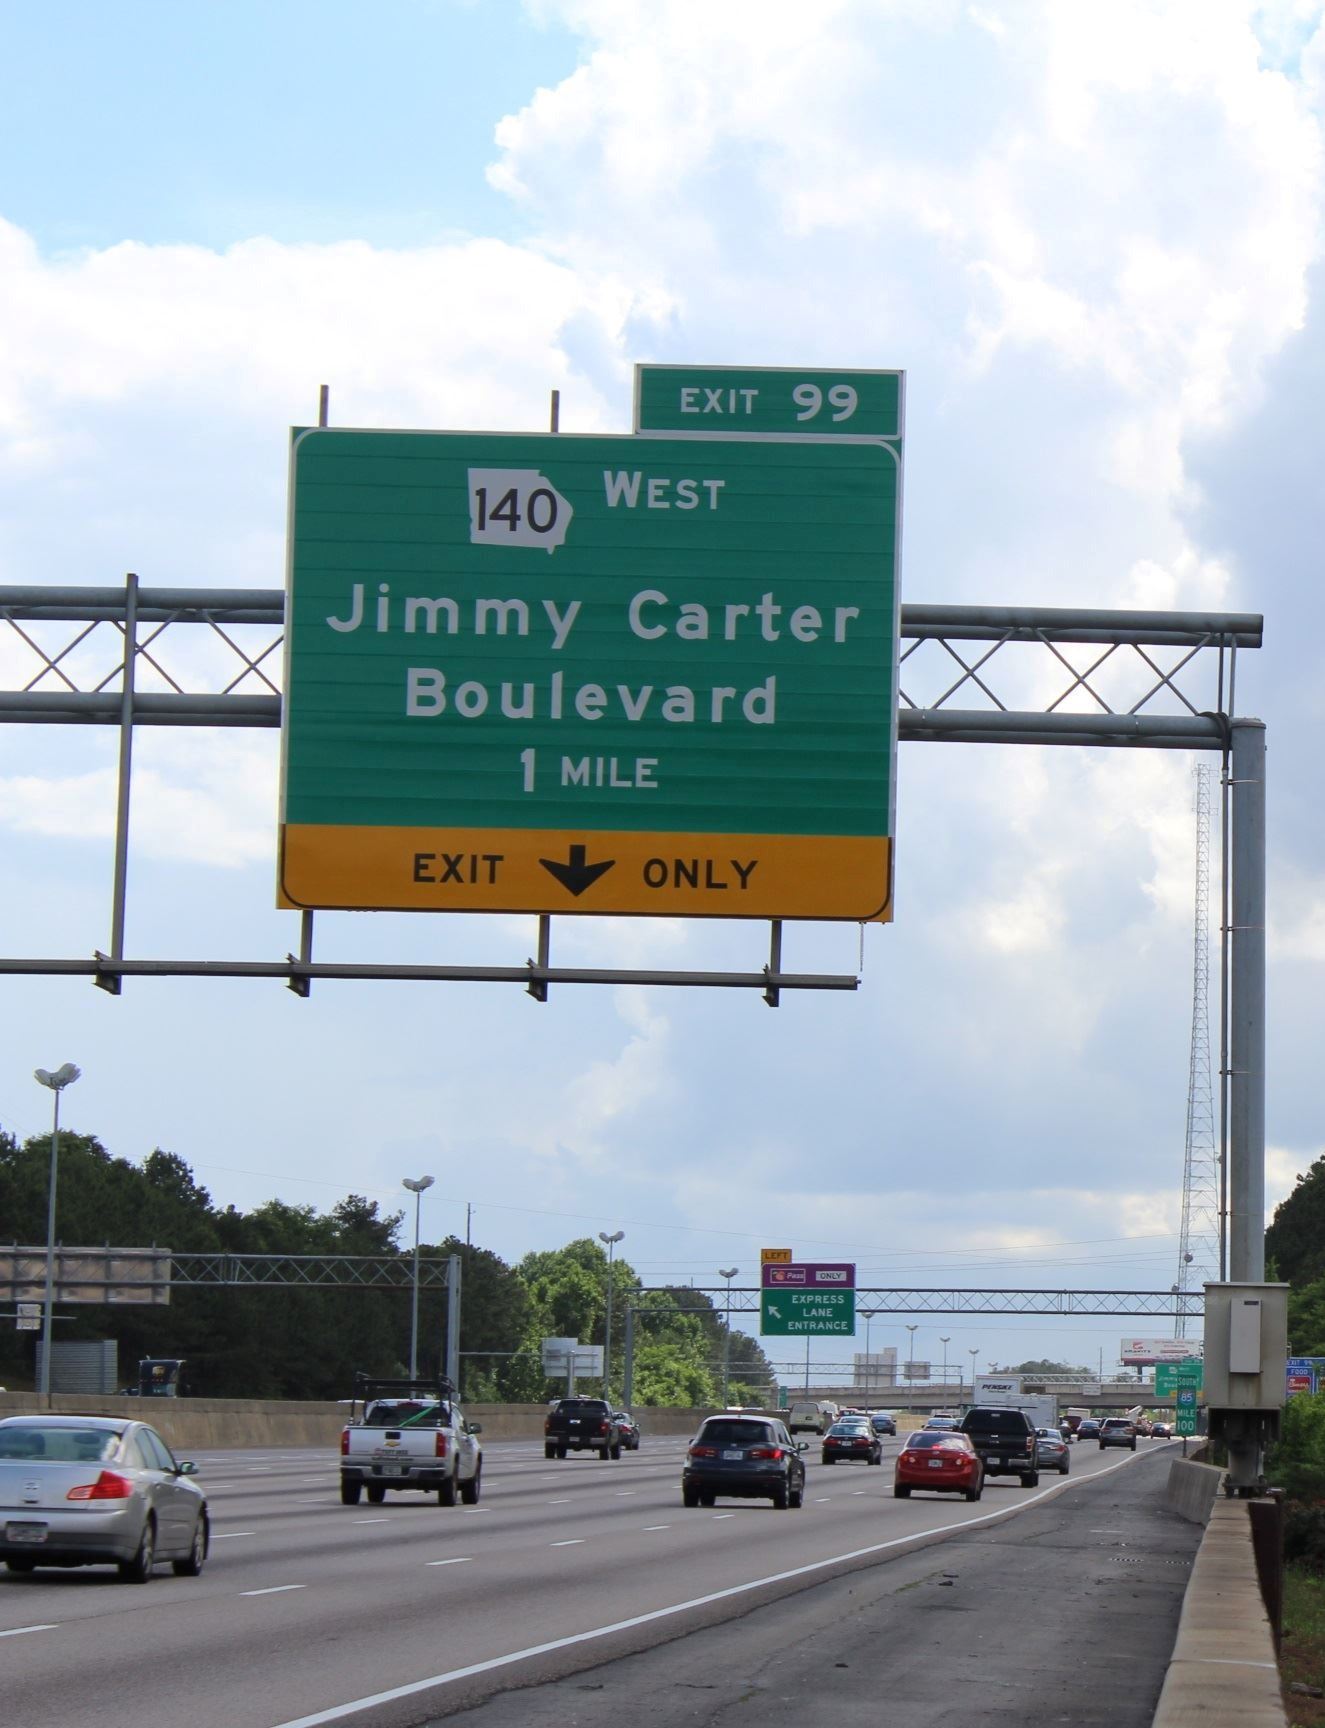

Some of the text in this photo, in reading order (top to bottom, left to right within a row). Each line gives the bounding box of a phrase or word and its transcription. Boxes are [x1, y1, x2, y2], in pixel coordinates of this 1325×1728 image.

[682, 384, 858, 422] EXIT 99
[604, 470, 725, 511] WEST
[475, 488, 558, 534] 140
[326, 583, 860, 649] Jimmy Carter
[407, 667, 777, 725] Boulevard
[519, 748, 659, 793] 1 MILE
[414, 853, 759, 891] EXIT ONLY
[765, 1252, 788, 1260] LEFT
[820, 1272, 842, 1280] ONLY
[791, 1295, 845, 1304] EXPRESS
[803, 1308, 833, 1317] LANE
[788, 1321, 849, 1330] ENTRANCE
[1181, 1393, 1193, 1402] 85
[1177, 1409, 1196, 1418] MILE
[1177, 1420, 1194, 1431] 100
